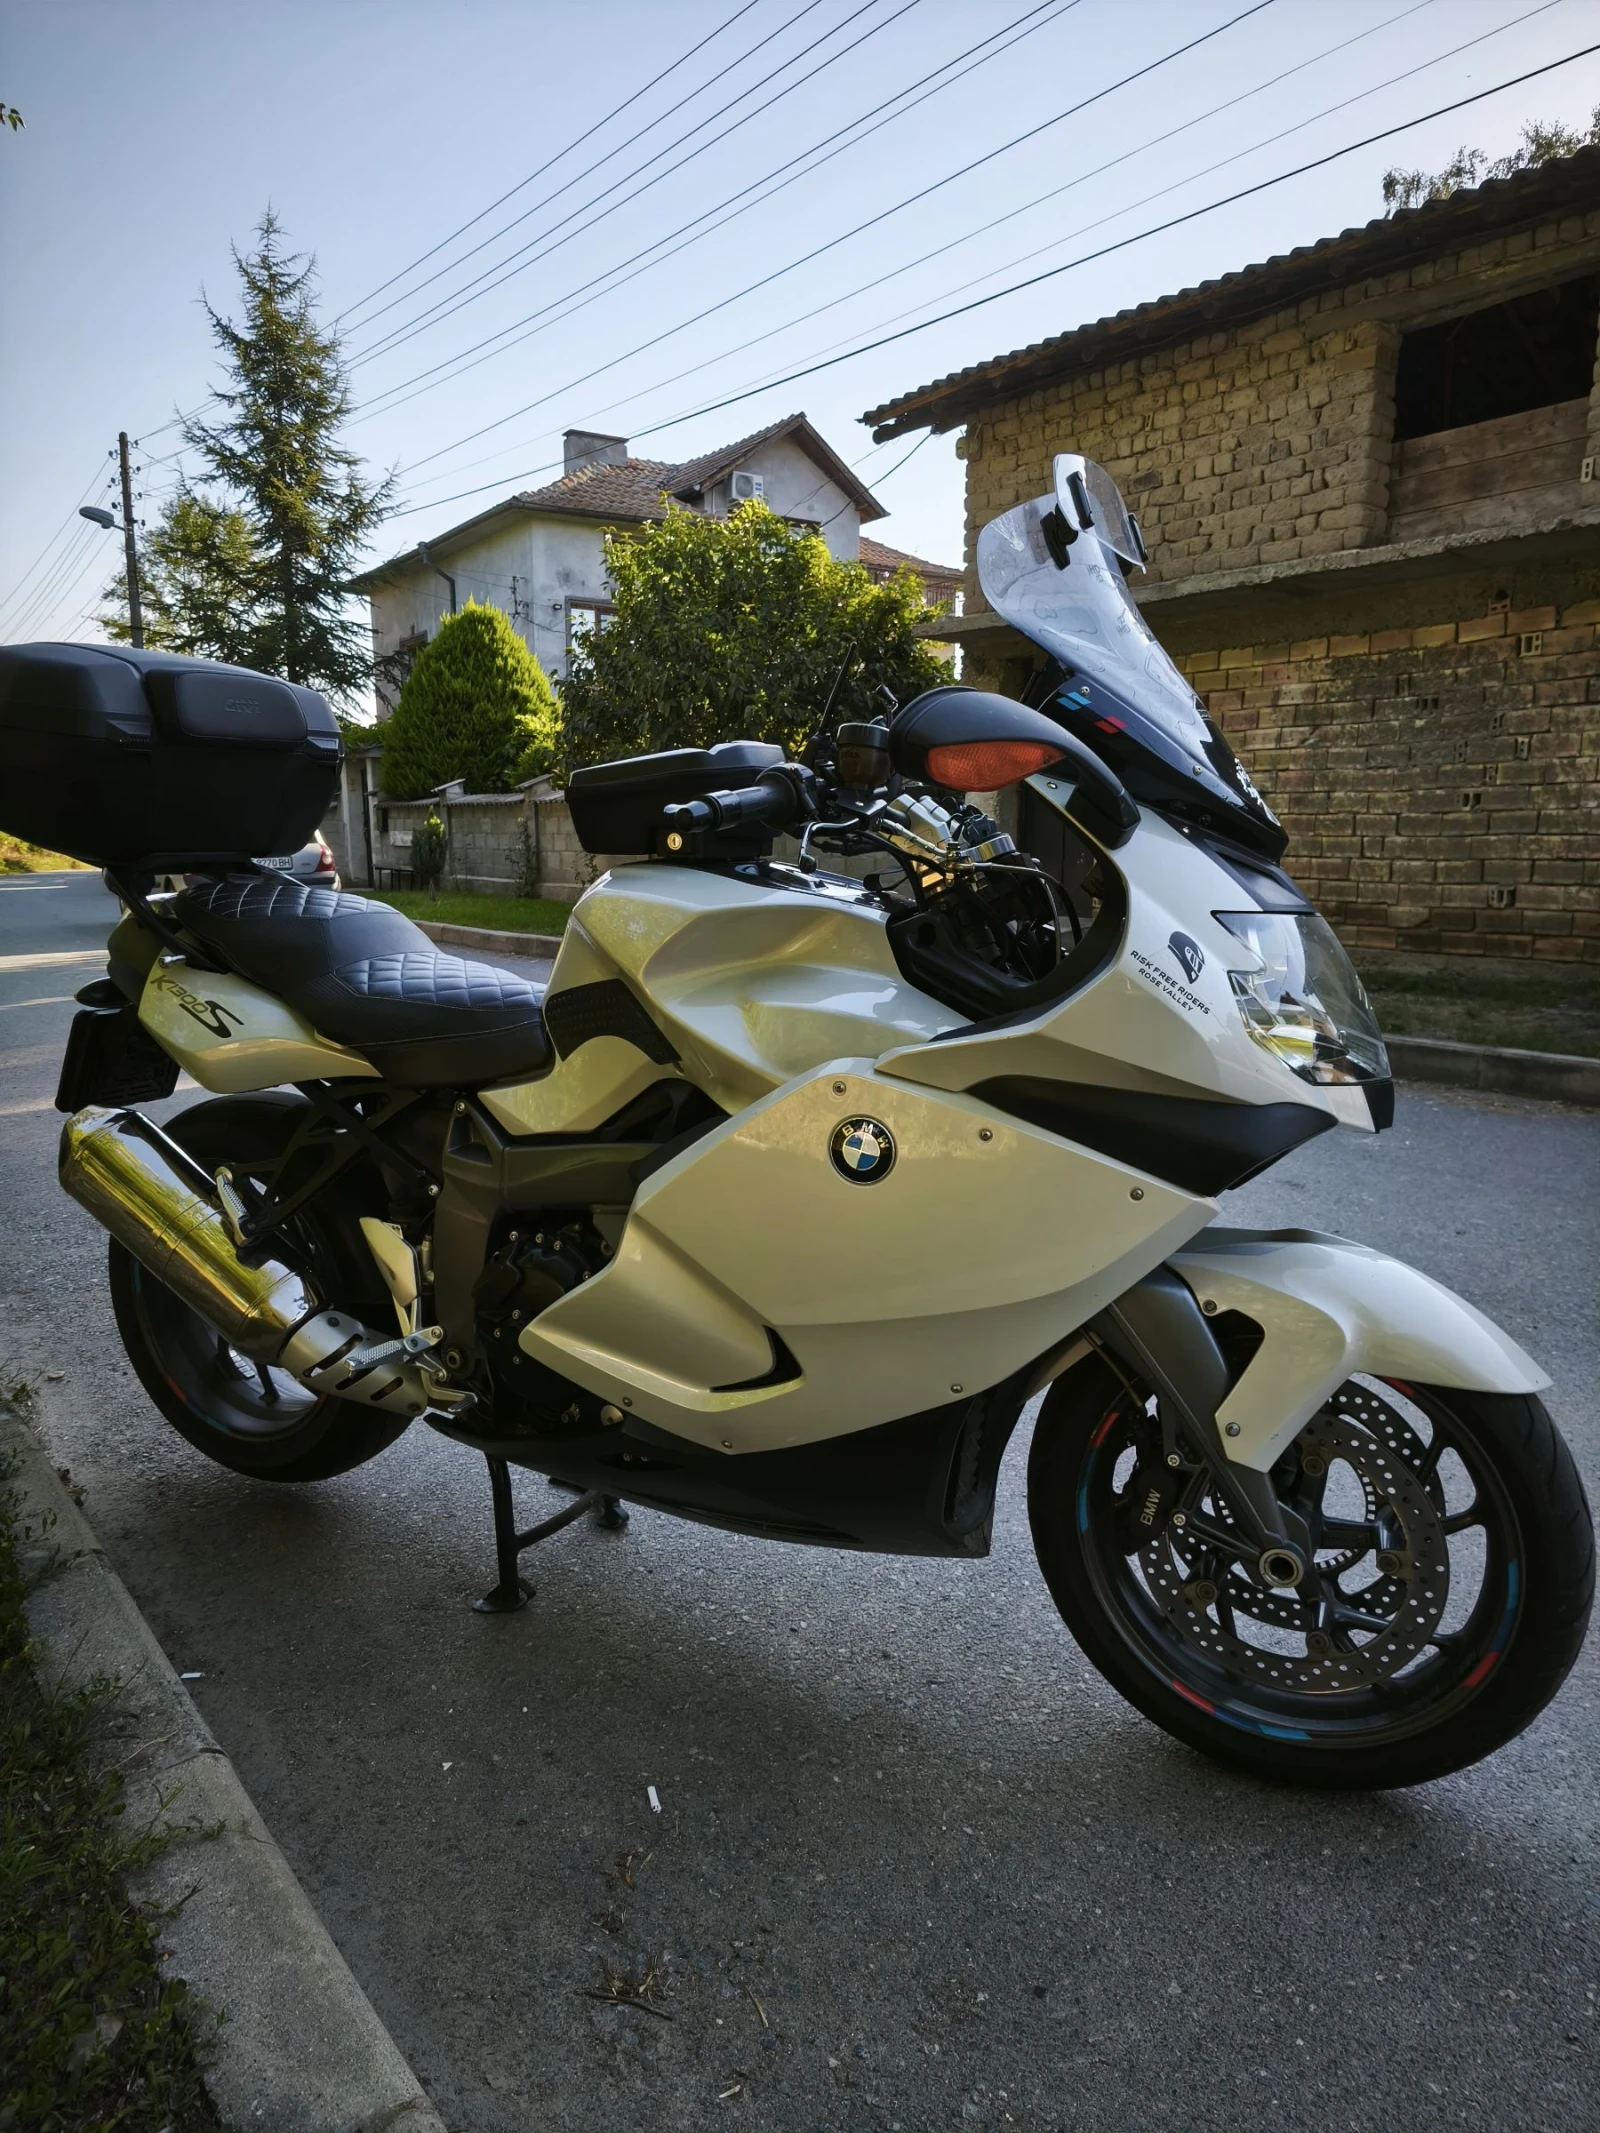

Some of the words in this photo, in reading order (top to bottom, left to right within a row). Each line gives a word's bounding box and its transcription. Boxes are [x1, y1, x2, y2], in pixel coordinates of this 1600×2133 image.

[1130, 950, 1154, 970] RISK
[1153, 966, 1179, 989] FREE
[1177, 985, 1211, 1015] RIDERS
[1138, 968, 1163, 988] ROSE
[1162, 985, 1194, 1012] VALLEY
[842, 1121, 890, 1149] BMW
[1140, 1488, 1161, 1526] BMW
